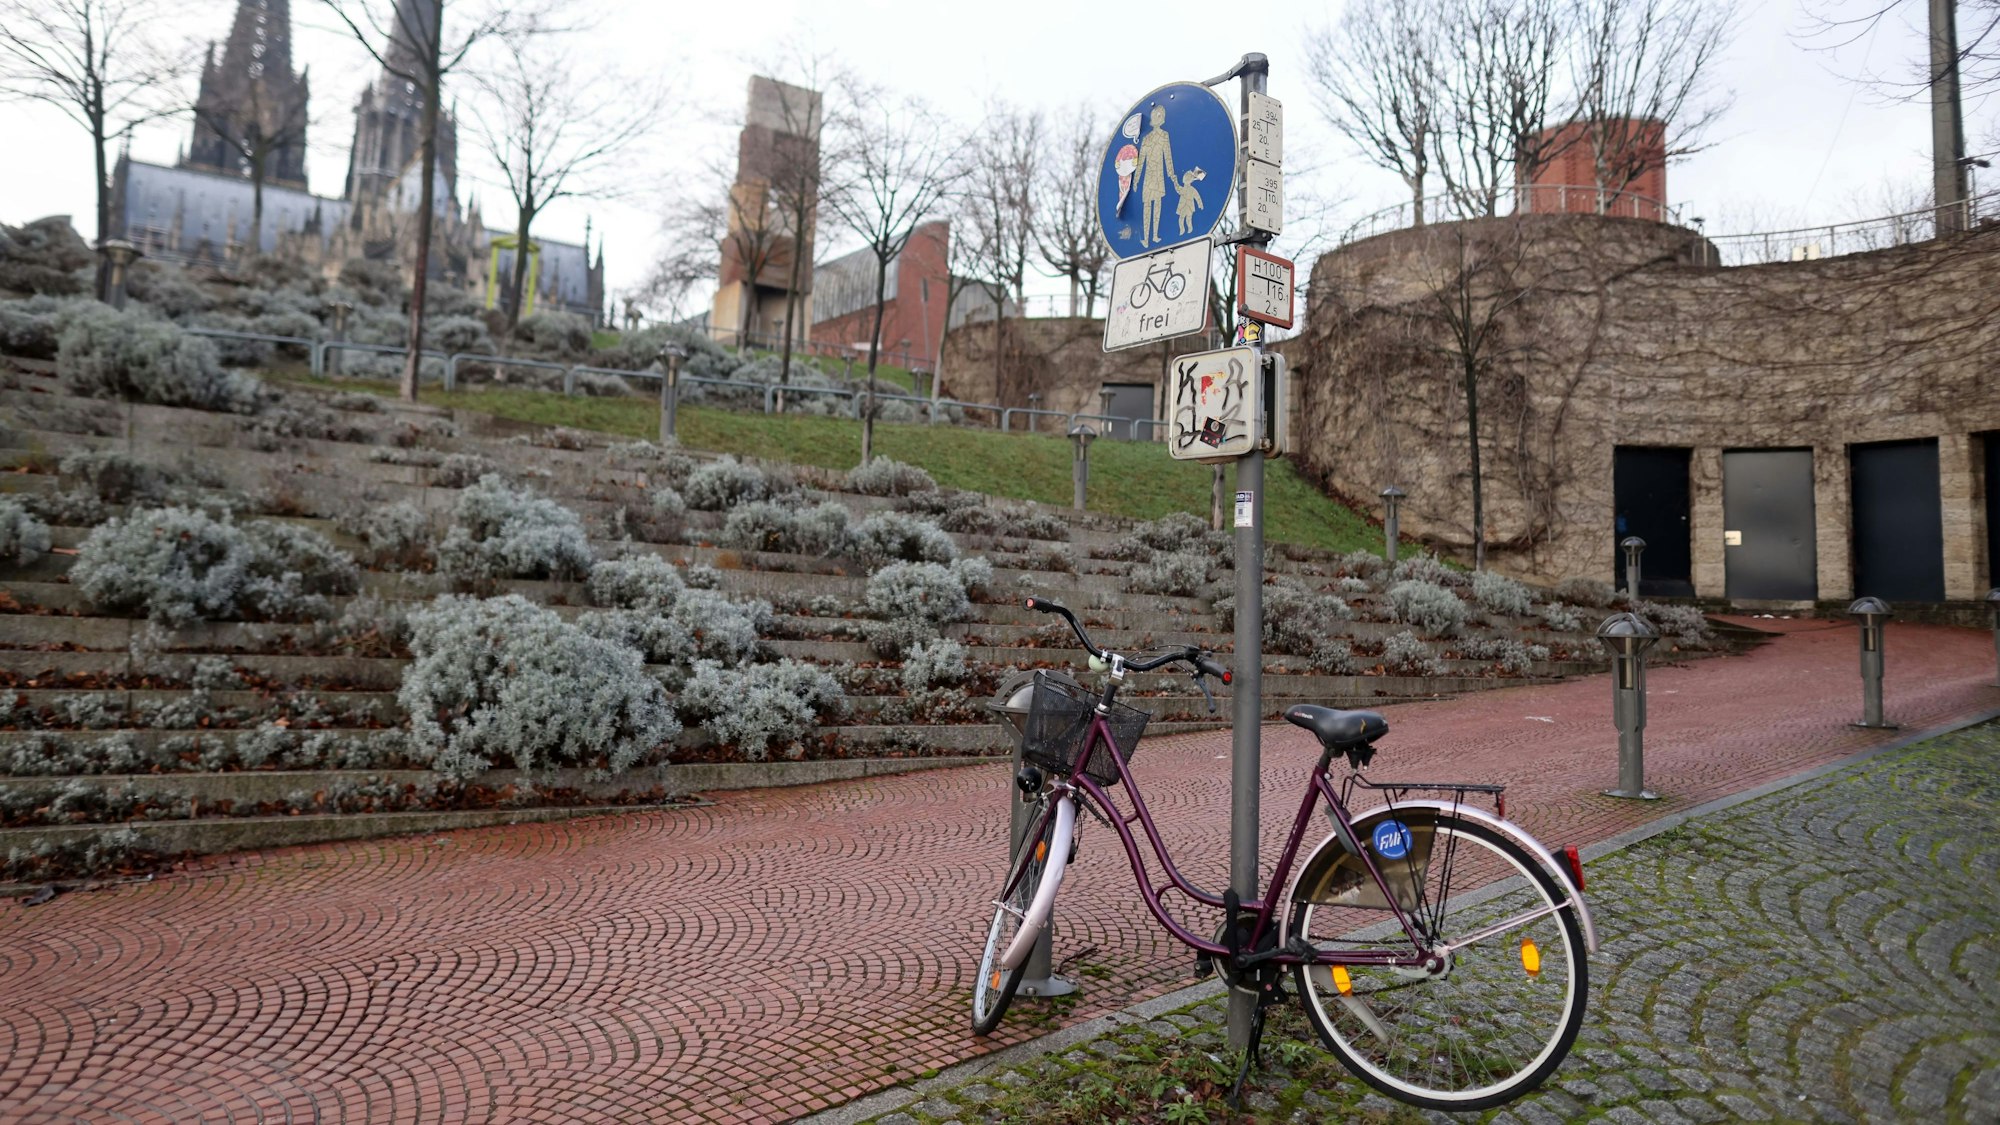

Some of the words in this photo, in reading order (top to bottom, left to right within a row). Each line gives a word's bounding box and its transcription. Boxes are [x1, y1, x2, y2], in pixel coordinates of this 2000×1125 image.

[1265, 110, 1278, 122] 394
[1265, 150, 1270, 159] E
[1264, 177, 1278, 189] 395
[1139, 308, 1170, 333] frei
